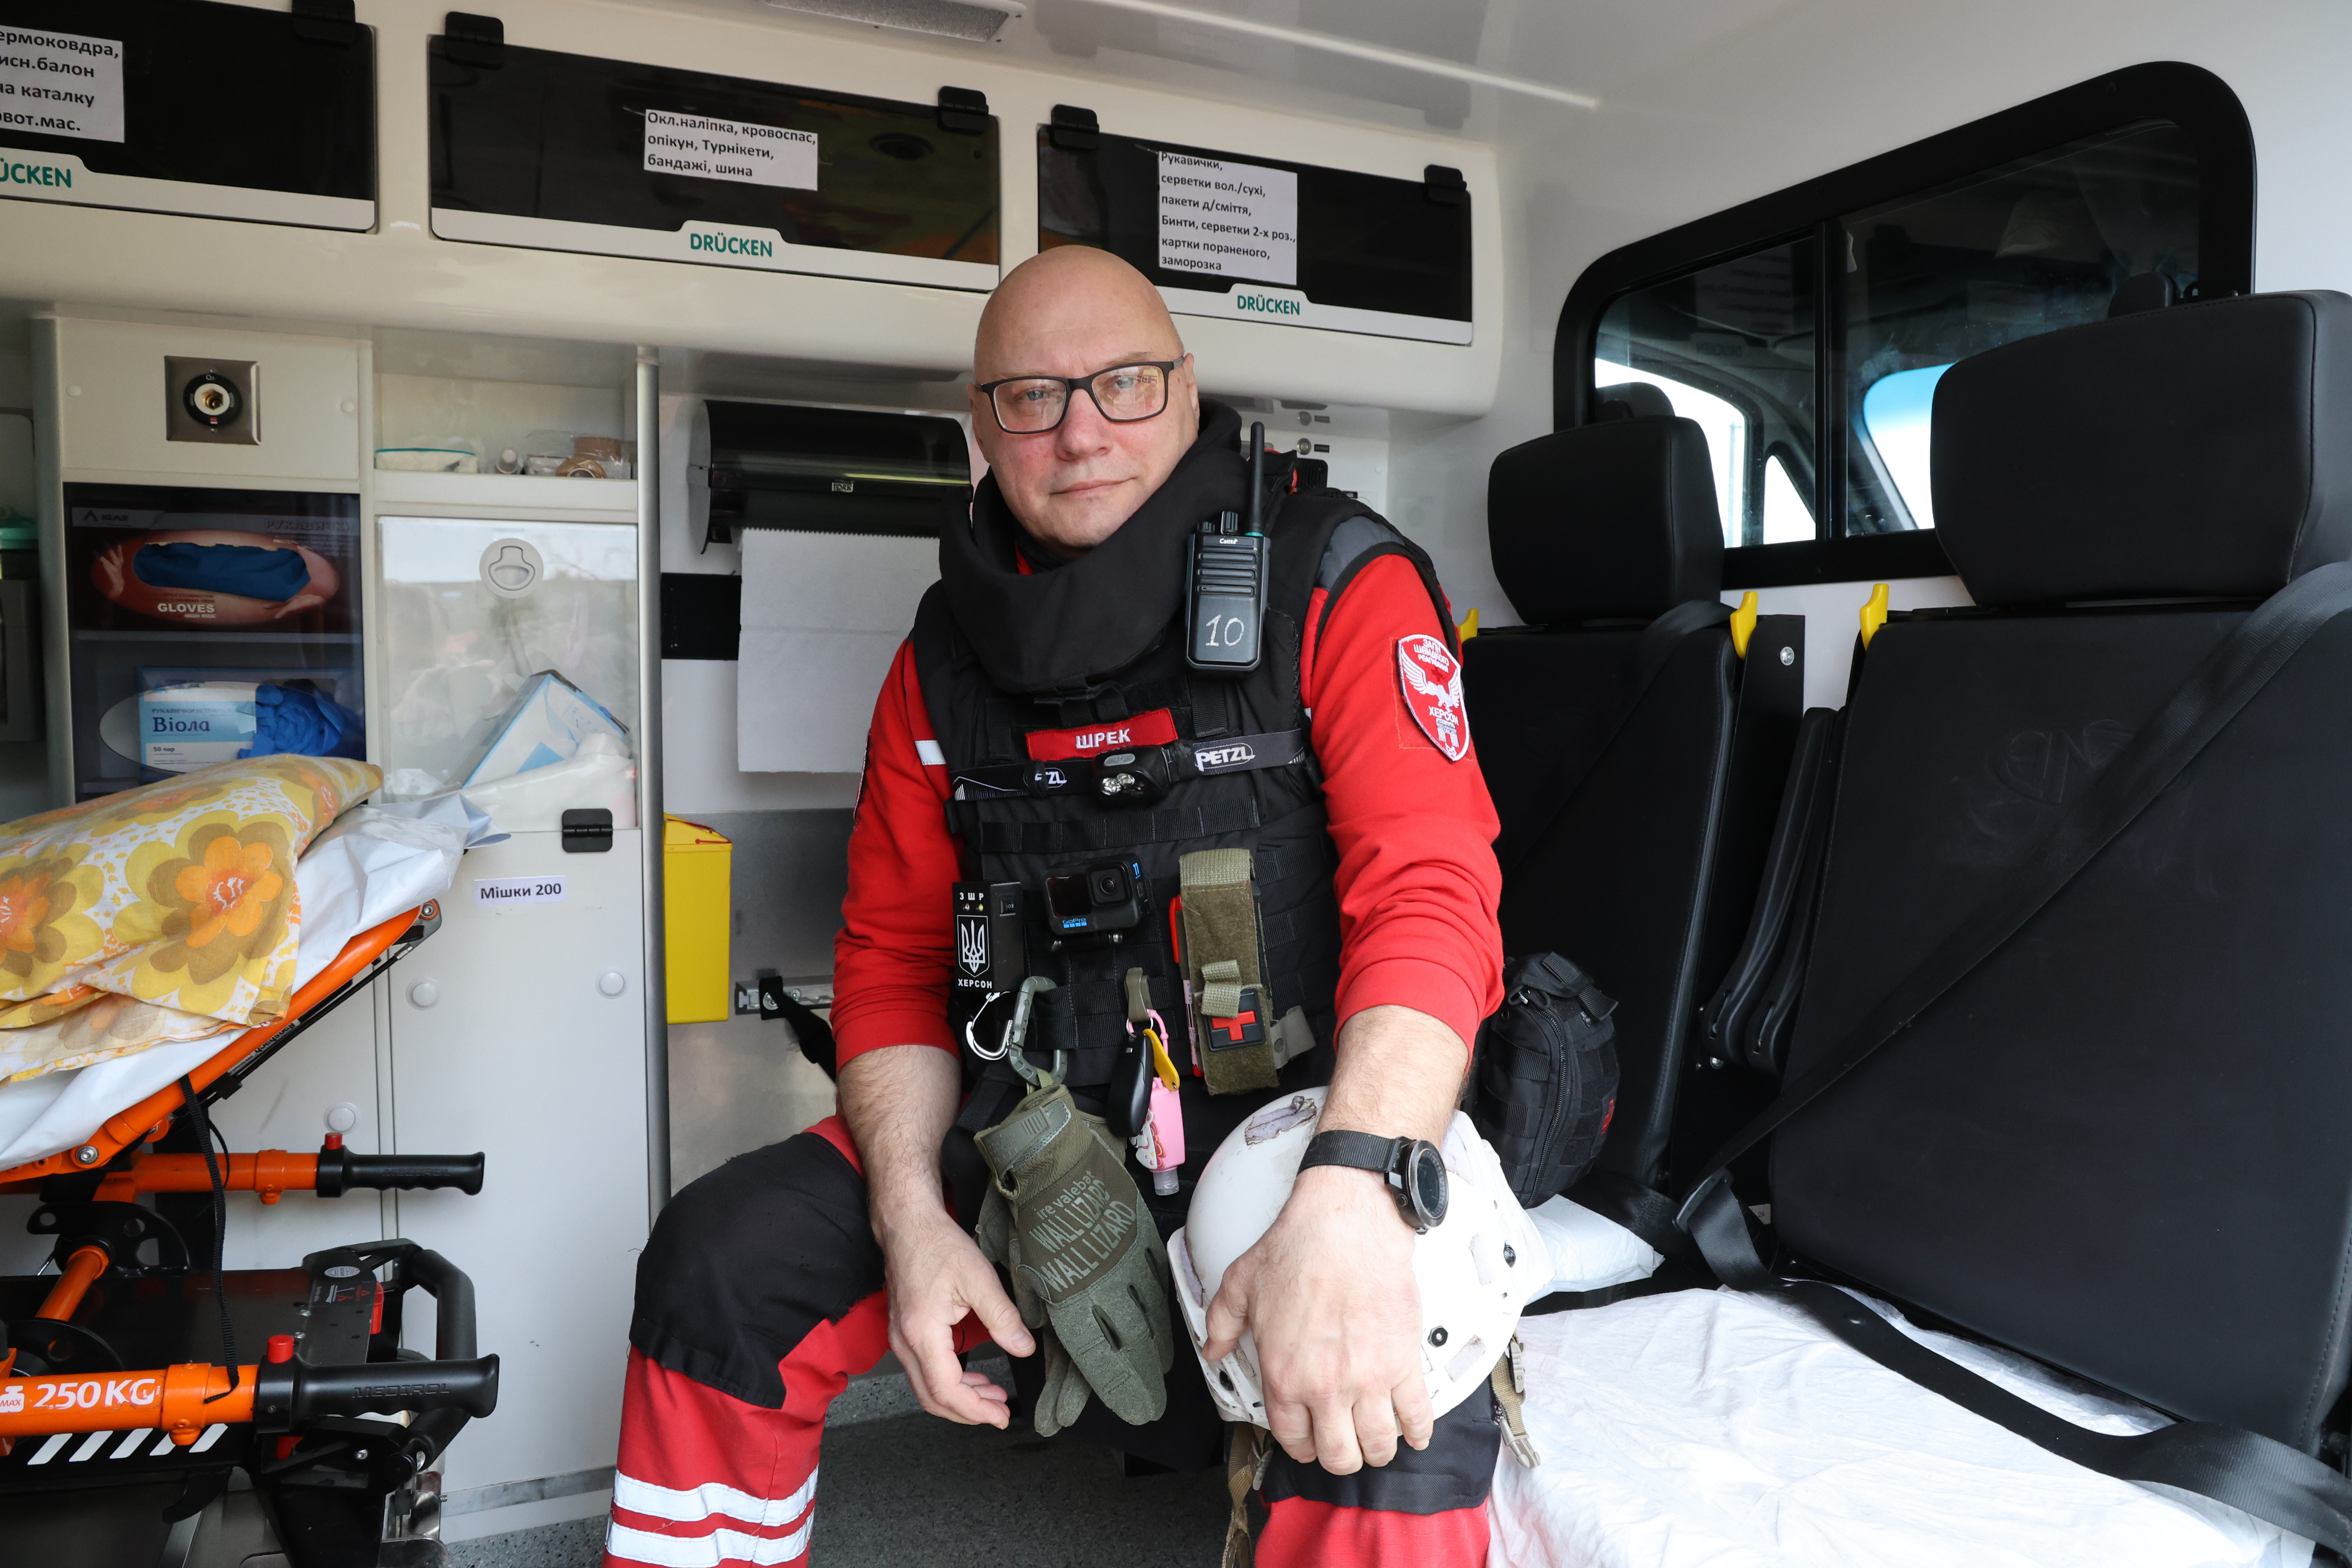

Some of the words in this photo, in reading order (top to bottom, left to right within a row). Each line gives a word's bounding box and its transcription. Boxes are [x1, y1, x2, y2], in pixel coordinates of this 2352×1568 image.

[21, 85, 95, 108] каталку
[0, 112, 81, 132] вот.мас.
[647, 111, 738, 136] Окл.наліпка,
[742, 125, 816, 145] кровоспас,
[648, 134, 698, 152] опікун,
[702, 139, 774, 160] Турнікети,
[647, 154, 711, 173] бандажі,
[715, 164, 753, 177] шина
[1161, 152, 1223, 171] Рукавички,
[1161, 174, 1212, 189] серветки
[1214, 181, 1266, 198] вол./сухі,
[1161, 195, 1200, 209] пакети
[1202, 199, 1252, 216] д/сміття,
[1161, 215, 1199, 230] Бинти,
[1201, 221, 1250, 236] серветки
[1252, 226, 1269, 238] 2-х
[1271, 229, 1296, 243] роз.,
[690, 231, 773, 258] DRÜCKEN
[1161, 237, 1200, 251] картки
[1203, 242, 1270, 260] пораненого,
[1161, 256, 1222, 271] заморозка
[1237, 293, 1300, 316] DRÜCKEN
[158, 603, 215, 613] GLOVES
[1205, 614, 1245, 647] 10
[1413, 644, 1450, 667] ШВИДКОГО
[152, 717, 210, 732] Віола
[1428, 705, 1459, 726] ХЕРСОН
[1075, 728, 1131, 749] ШРЕК
[1195, 743, 1256, 771] PETZL
[480, 885, 531, 899] Мішки
[536, 883, 562, 896] 200
[958, 978, 993, 988] ХЕРСОН
[1052, 1170, 1094, 1208] valebat
[1029, 1214, 1085, 1253] WALL
[1064, 1179, 1110, 1229] LIZARD
[1040, 1247, 1100, 1293] WALL
[1082, 1200, 1136, 1261] LIZARD
[0, 1399, 21, 1407] MAX
